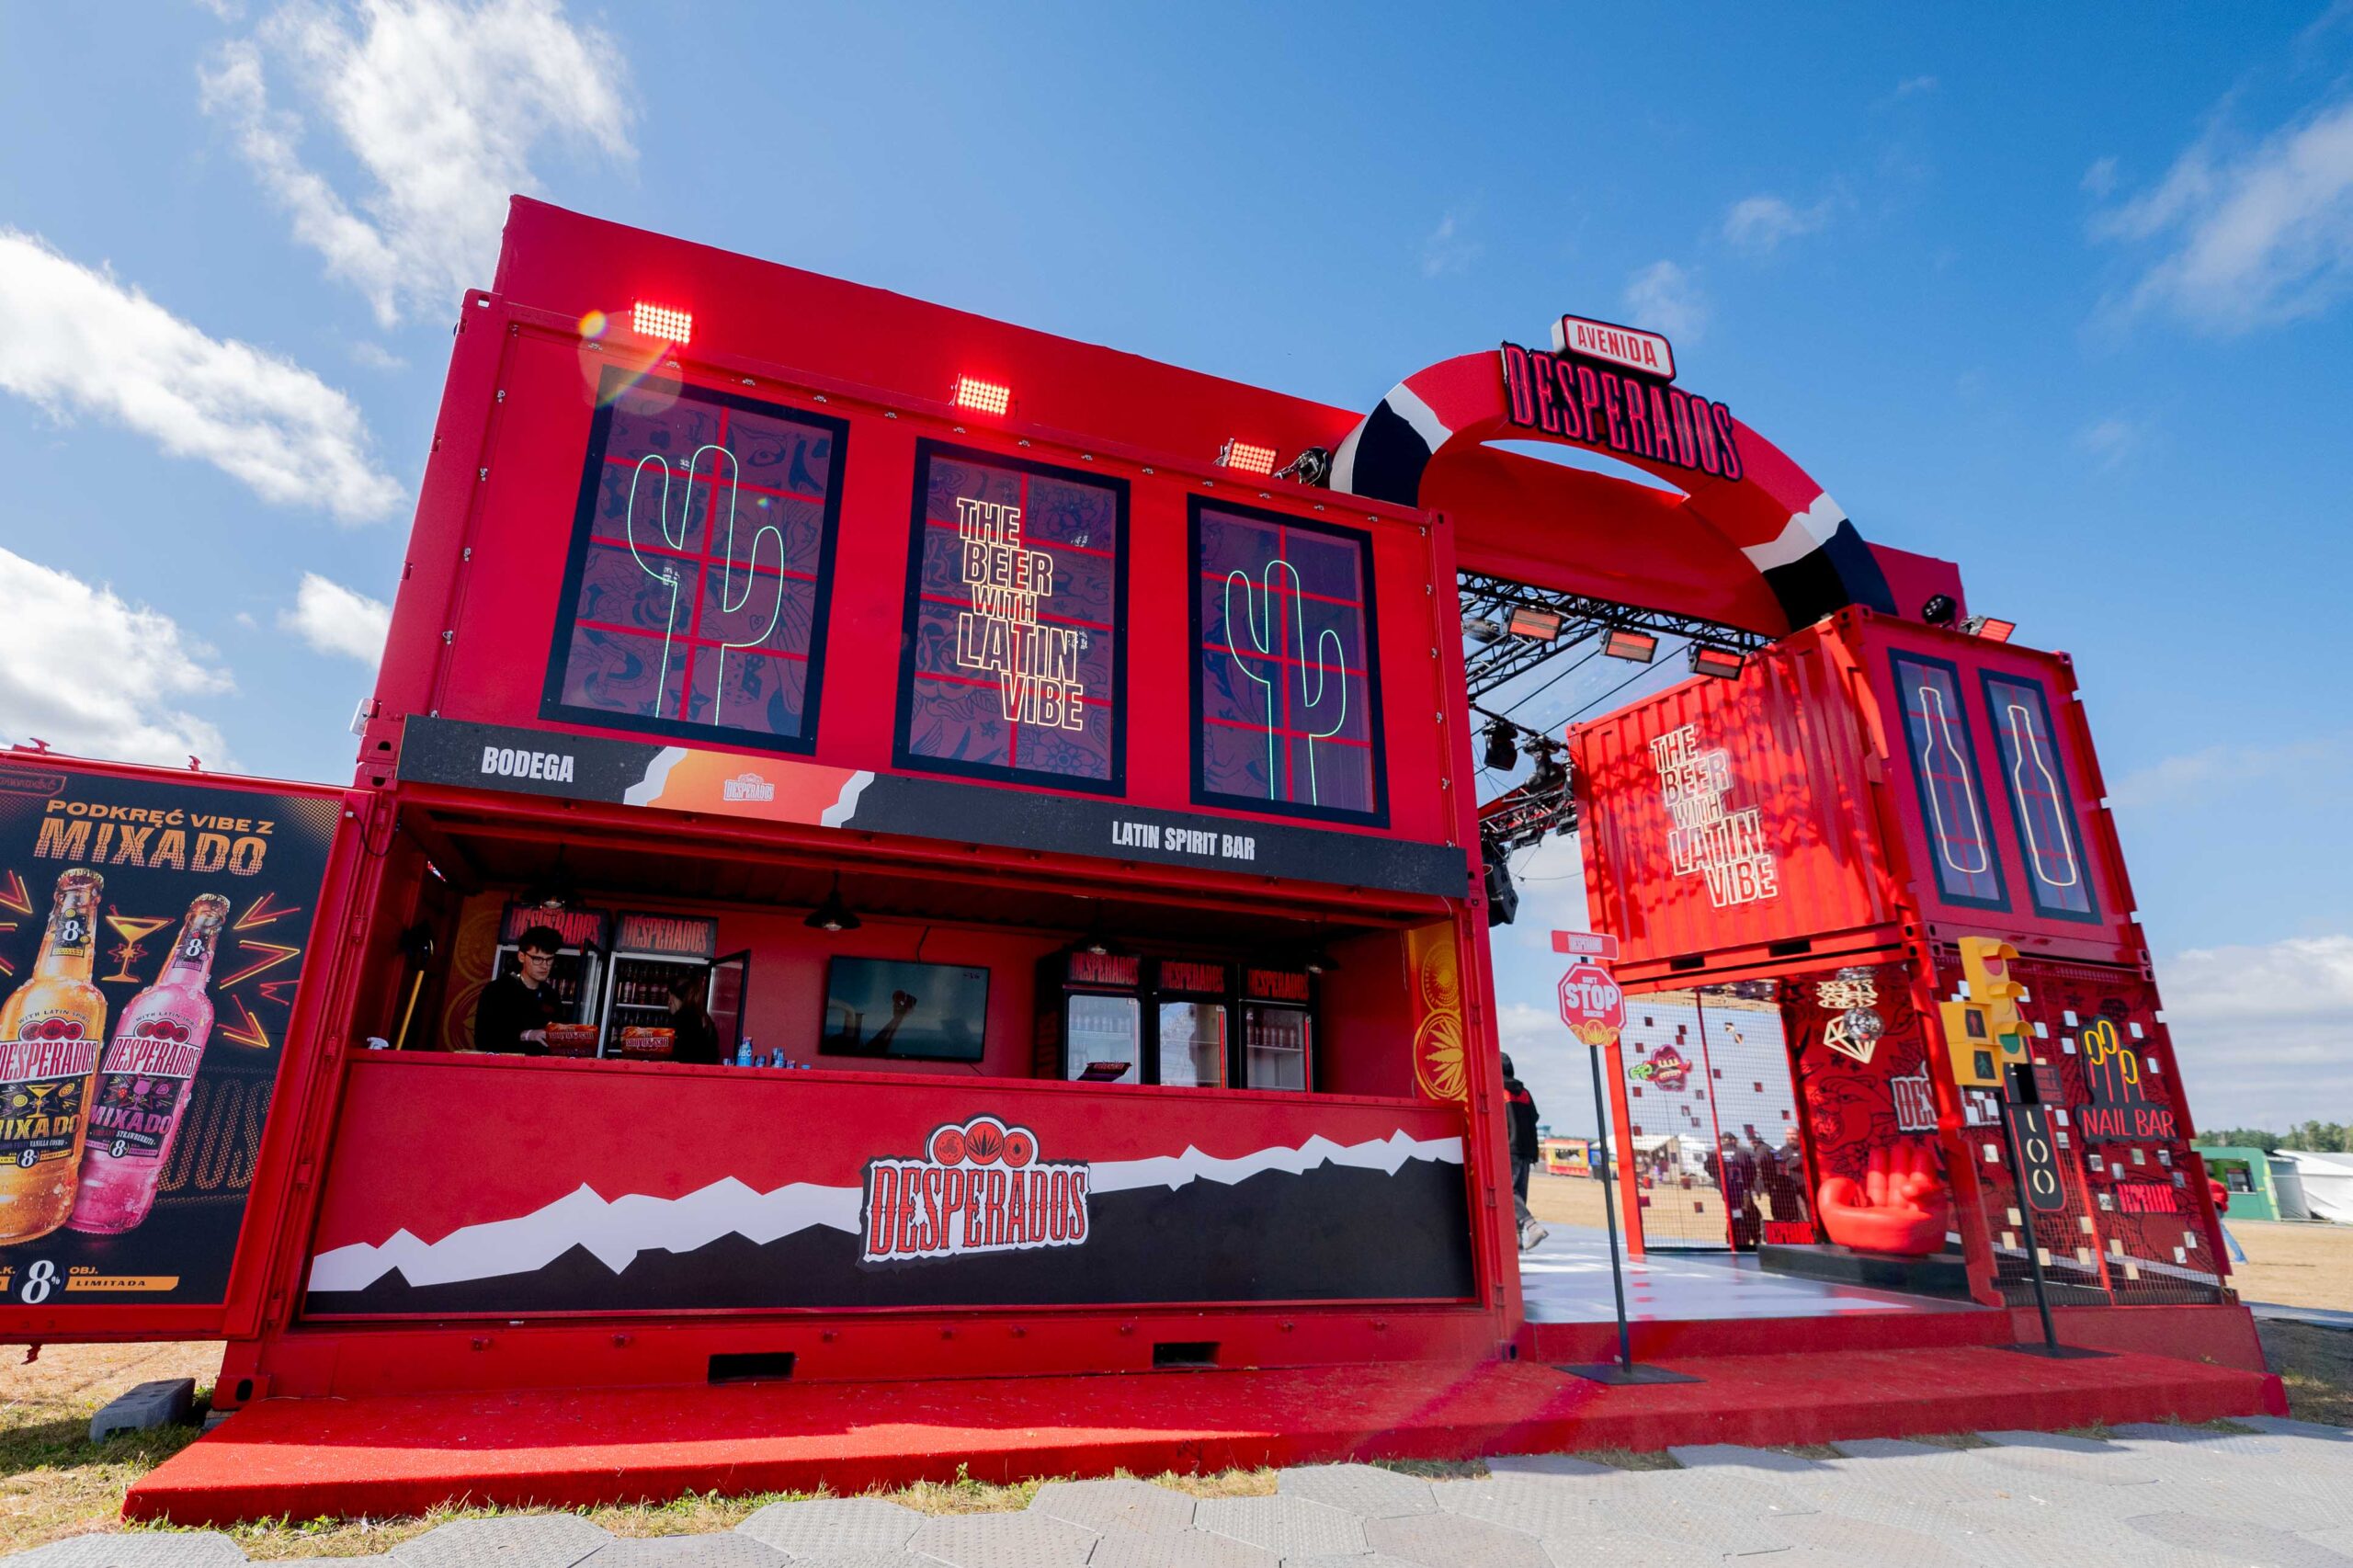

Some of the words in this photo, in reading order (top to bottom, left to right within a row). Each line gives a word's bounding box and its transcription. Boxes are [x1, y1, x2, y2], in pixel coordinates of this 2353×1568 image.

[1576, 324, 1659, 369] AVENIDA
[1505, 343, 1744, 482] DESPERADOS
[957, 497, 1020, 548] THE
[962, 540, 1053, 596] BEER
[972, 585, 1037, 623] WITH
[957, 612, 1077, 683] LATIN
[1001, 673, 1083, 731] VIBE
[481, 745, 574, 783] BODEGA
[1650, 724, 1699, 773] THE
[1662, 753, 1730, 807] BEER
[46, 799, 185, 828] PODKRĘĆ
[190, 813, 252, 832] VIBE
[256, 821, 274, 835] Z
[1672, 792, 1722, 827] WITH
[33, 817, 267, 876] MIXADO
[1112, 821, 1160, 849] LATIN
[1165, 827, 1218, 856] SPIRIT
[1222, 835, 1256, 860] BAR
[1668, 810, 1764, 876] LATIN
[1706, 855, 1778, 908] VIBE
[621, 915, 709, 953] DESPERADOS
[1071, 952, 1139, 986] DESPERADOS
[1565, 983, 1618, 1011] STOP
[18, 1012, 40, 1024] WITH
[0, 1042, 97, 1081] DESPERADOS
[105, 1039, 199, 1076] DESPERADOS
[2082, 1108, 2131, 1138] NAIL
[2134, 1108, 2177, 1138] BAR
[868, 1165, 1086, 1256] DESPERADOS
[69, 1267, 98, 1275] OBJ.
